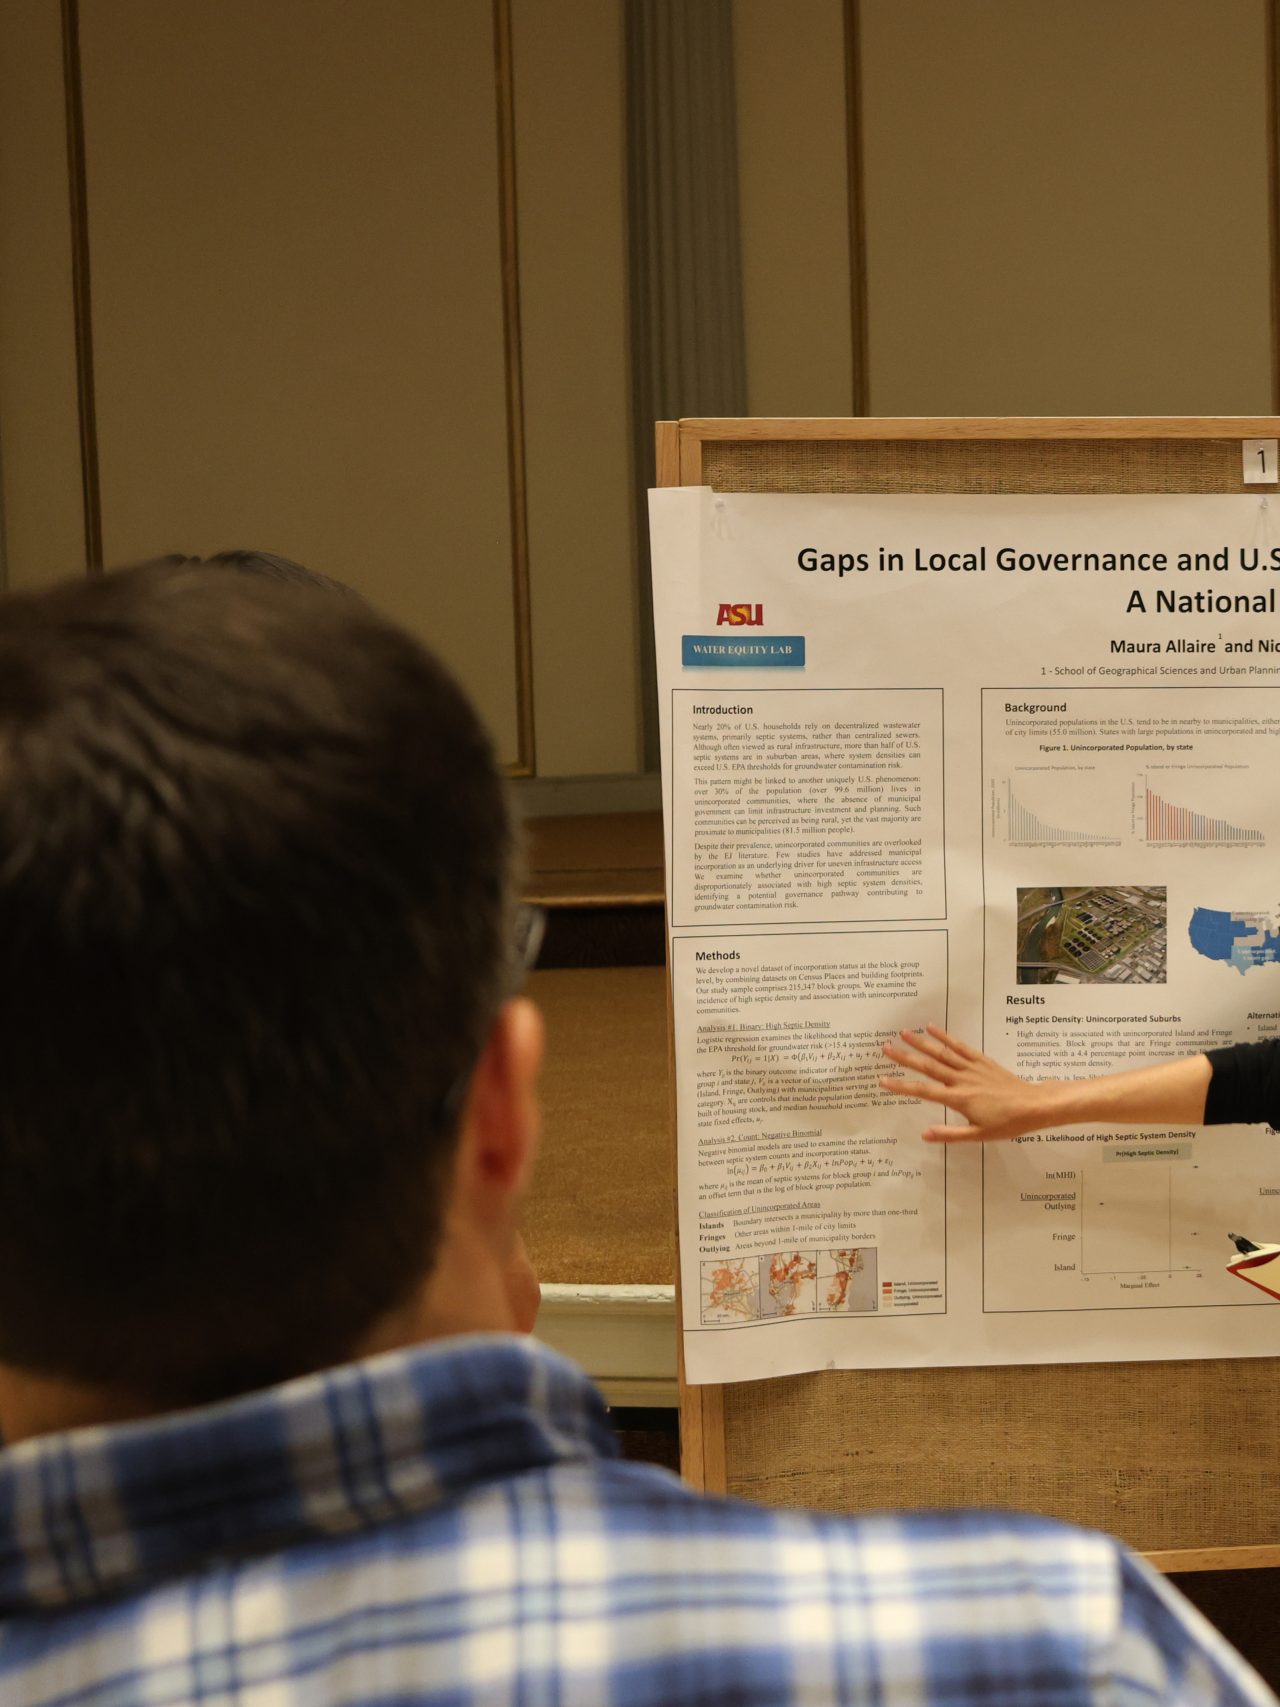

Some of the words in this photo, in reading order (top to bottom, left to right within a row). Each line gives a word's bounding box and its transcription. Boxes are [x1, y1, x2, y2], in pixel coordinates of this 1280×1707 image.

[1257, 450, 1266, 474] 1
[797, 548, 868, 576] Gaps
[879, 547, 903, 571] in
[915, 547, 985, 571] Local
[996, 548, 1167, 571] Governance
[1177, 547, 1228, 570] and
[1126, 590, 1146, 612] A
[1156, 589, 1274, 612] National
[716, 603, 763, 625] ASU
[728, 646, 767, 655] EQUITY
[1110, 640, 1160, 652] Maura
[1165, 639, 1215, 652] Allaire
[1224, 639, 1252, 652] and
[1054, 666, 1084, 675] School
[1086, 666, 1096, 675] of
[1098, 666, 1157, 676] Geographical
[693, 705, 753, 714] Introduction
[1004, 702, 1066, 714] Background
[695, 950, 740, 960] Methods
[1006, 995, 1045, 1004] Results
[1025, 1015, 1049, 1024] Septic
[1020, 1192, 1075, 1201] Unincorporated
[699, 1208, 742, 1218] Classification
[752, 1203, 801, 1212] Unincorporated
[1044, 1202, 1075, 1211] Outlying
[733, 1217, 762, 1227] Boundary
[800, 1211, 841, 1220] municipality
